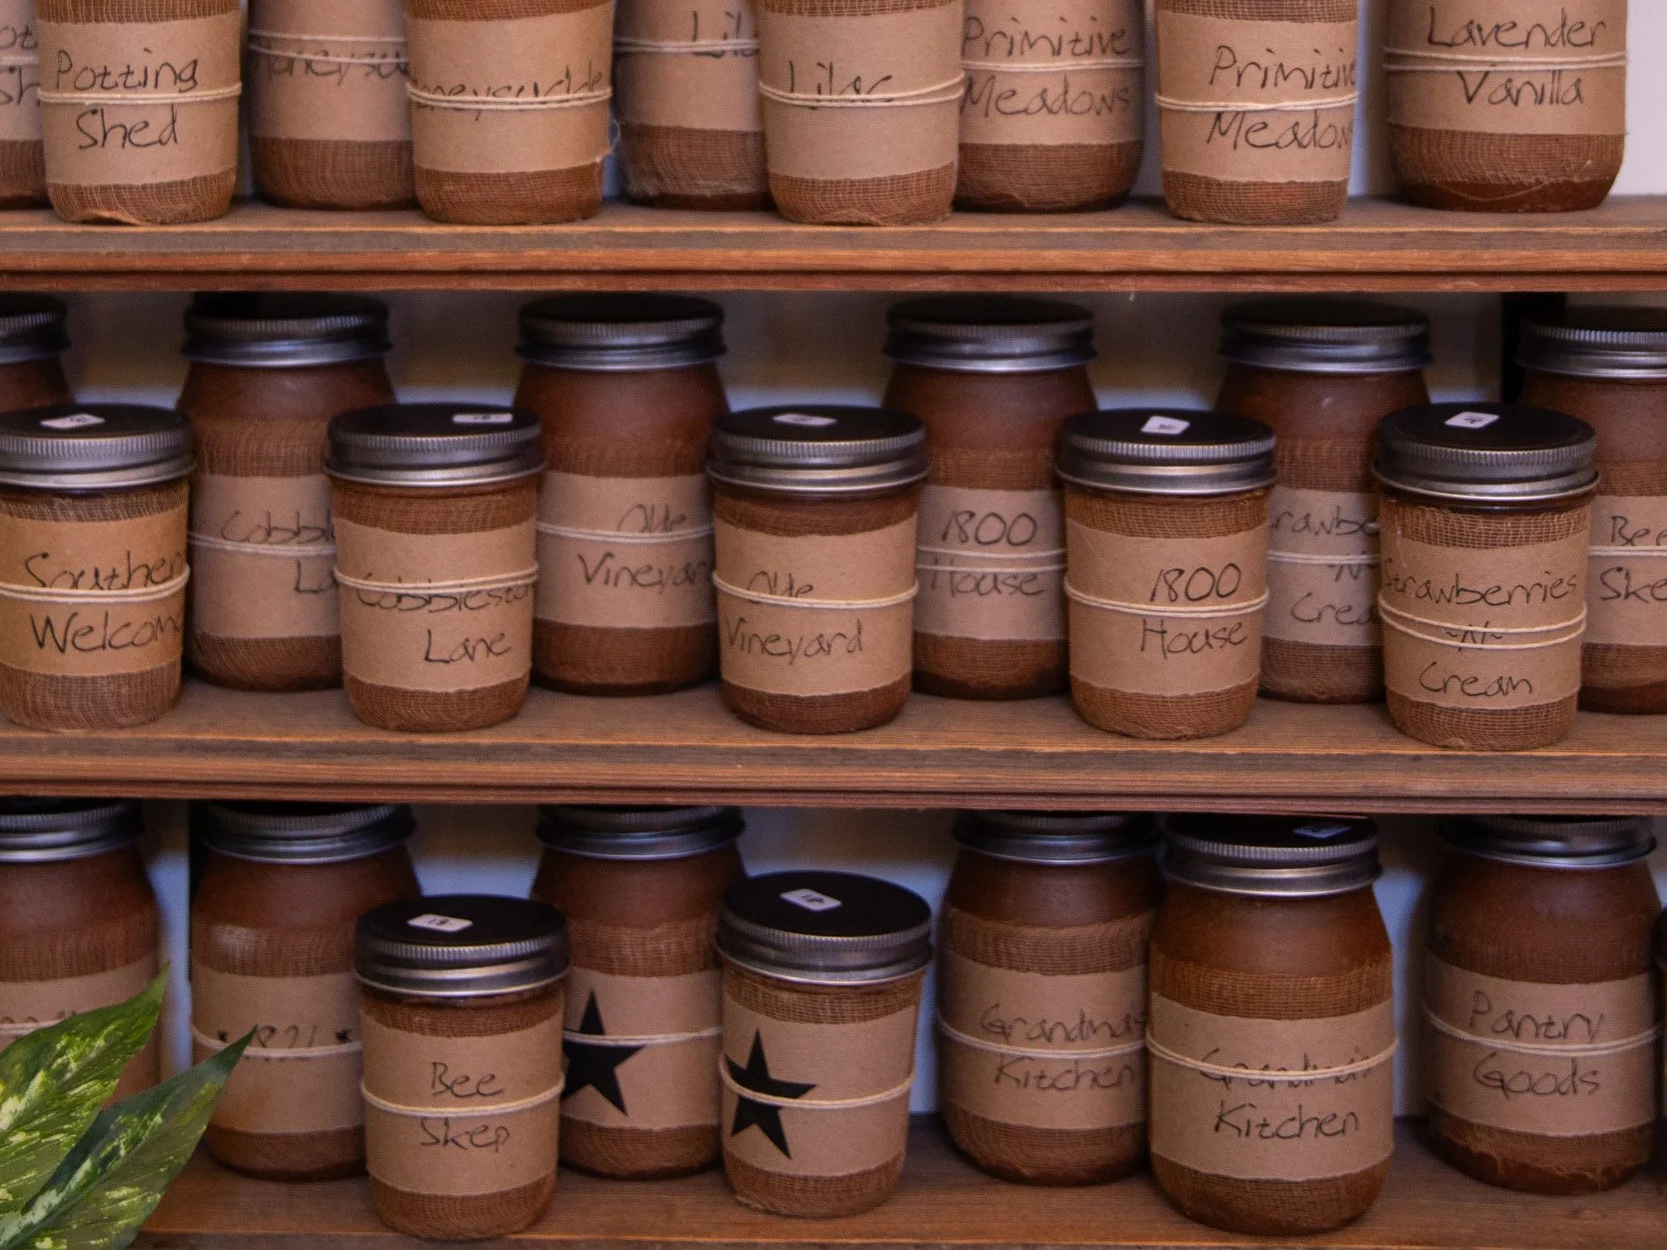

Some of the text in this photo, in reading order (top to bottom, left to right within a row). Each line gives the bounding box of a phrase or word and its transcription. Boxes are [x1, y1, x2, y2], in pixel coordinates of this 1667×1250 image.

[961, 15, 1133, 58] Primitive
[1427, 6, 1607, 49] Lavender
[56, 47, 200, 93] Potting
[1456, 67, 1584, 107] Vanilla
[76, 105, 178, 150] Shed
[941, 510, 1038, 547] 1800
[930, 556, 1046, 598] House
[1149, 561, 1242, 603] 1800
[423, 628, 512, 664] Lane
[1139, 618, 1248, 660] House
[1418, 660, 1533, 698] Cream
[1468, 990, 1605, 1043] Pantry
[430, 1060, 506, 1099] Bee
[994, 1056, 1135, 1092] Kitchen
[1473, 1051, 1601, 1101] Goods
[419, 1116, 512, 1154] Skep
[1214, 1099, 1360, 1140] Kitchen
